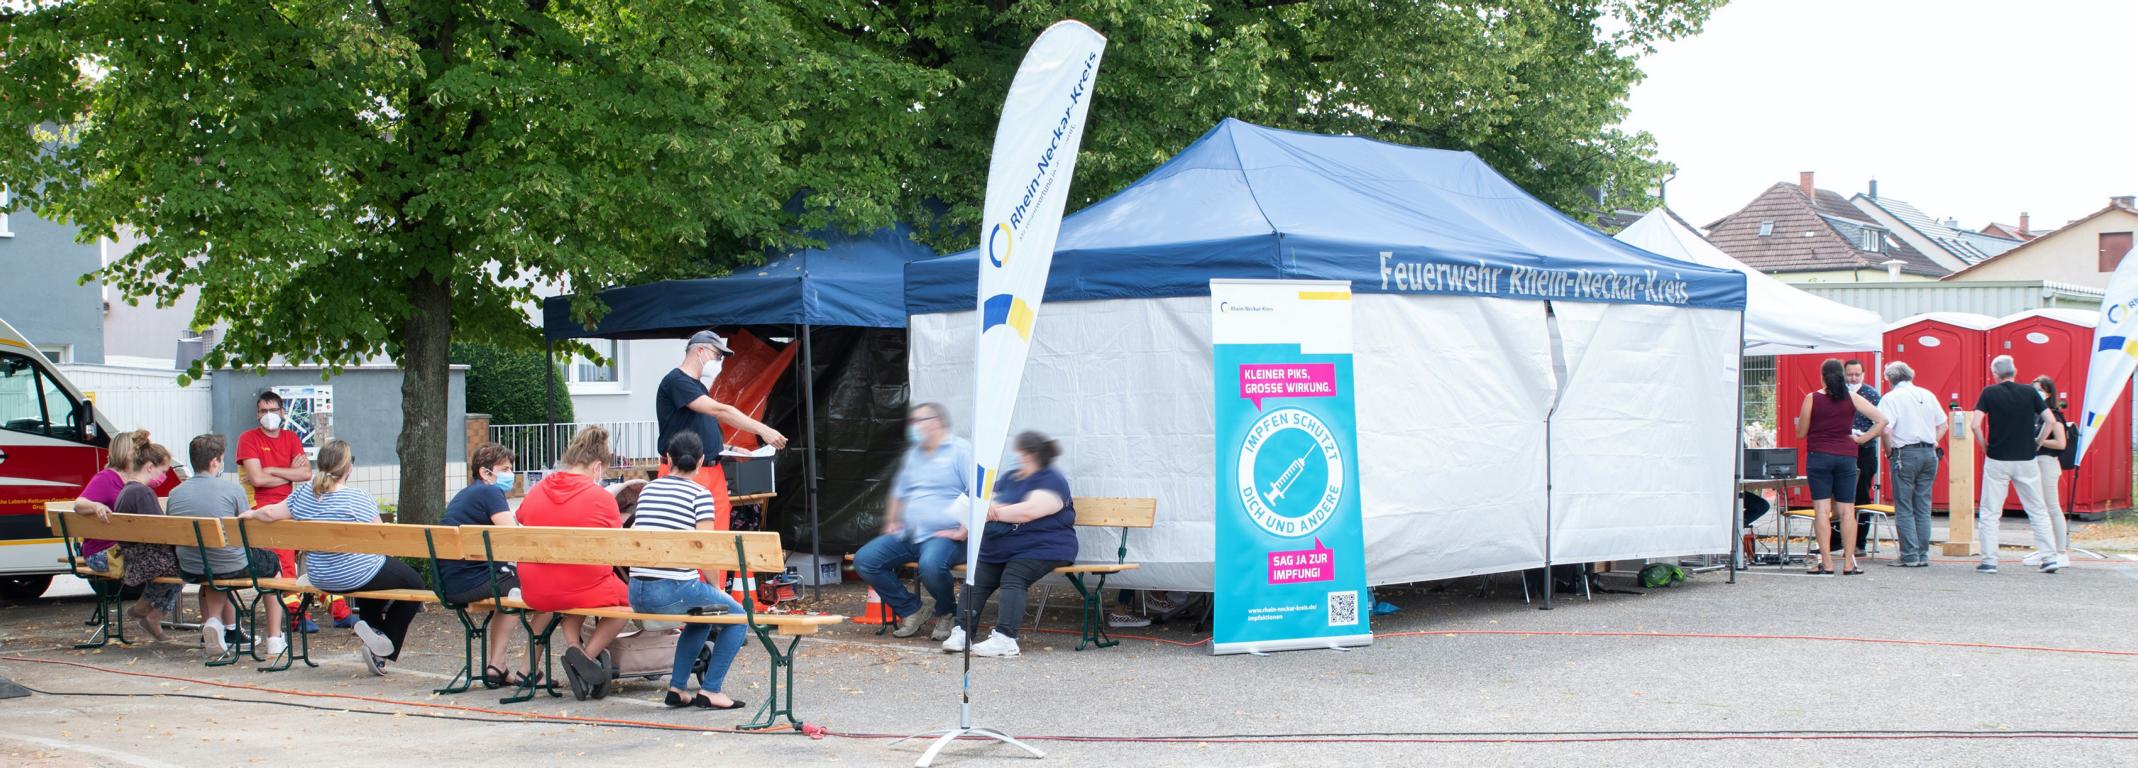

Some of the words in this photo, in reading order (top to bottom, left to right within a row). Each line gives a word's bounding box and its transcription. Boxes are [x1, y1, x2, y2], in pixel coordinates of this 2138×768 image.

[1010, 51, 1097, 230] Rhein-Neckar-Kreis
[1379, 251, 1503, 292] Feuerwehr
[1509, 264, 1689, 305] Rhein-Neckar-Kreis
[1244, 369, 1285, 380] KLEINER
[1287, 368, 1311, 380] PIKS,
[1245, 382, 1284, 394] GROSSE
[1286, 382, 1332, 394] WIRKUNG.
[1245, 413, 1289, 453] IMPFEN
[1293, 413, 1338, 461] SCHÜTZT
[1243, 486, 1265, 520] DICH
[1266, 516, 1295, 533] UND
[1300, 485, 1339, 533] ANDERE
[1273, 556, 1294, 567] SAG
[1295, 555, 1307, 566] JA
[1309, 553, 1328, 565] ZUR
[1273, 567, 1321, 581] IMPFUNG!
[1248, 614, 1283, 622] impfaktionen
